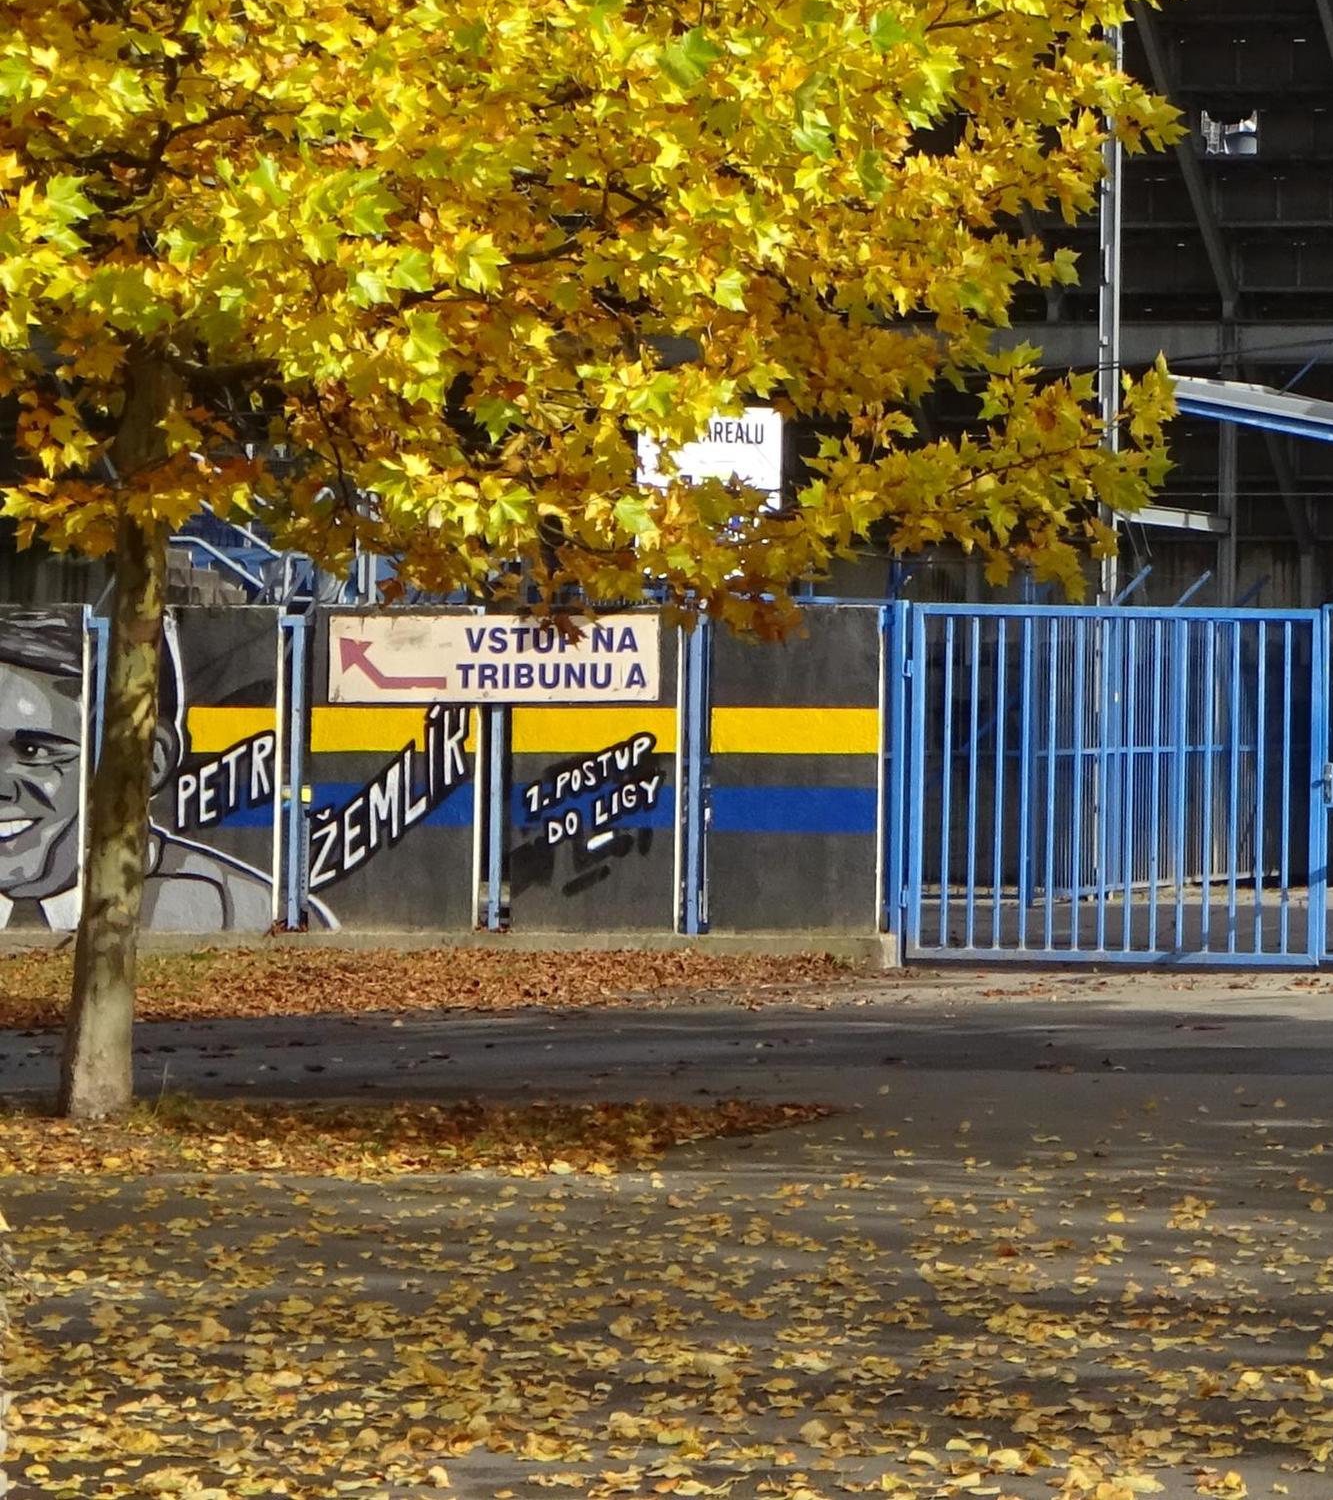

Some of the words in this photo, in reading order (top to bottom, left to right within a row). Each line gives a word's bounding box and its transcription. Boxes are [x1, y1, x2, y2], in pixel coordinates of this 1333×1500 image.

[591, 627, 639, 654] NA
[456, 662, 613, 690] TRIBUNU
[625, 662, 647, 690] A
[177, 735, 274, 829] PETR
[309, 704, 467, 889] ŽEMLÍK
[555, 736, 651, 799] POSTUP
[547, 811, 578, 844] DO
[595, 775, 660, 827] LIGY
